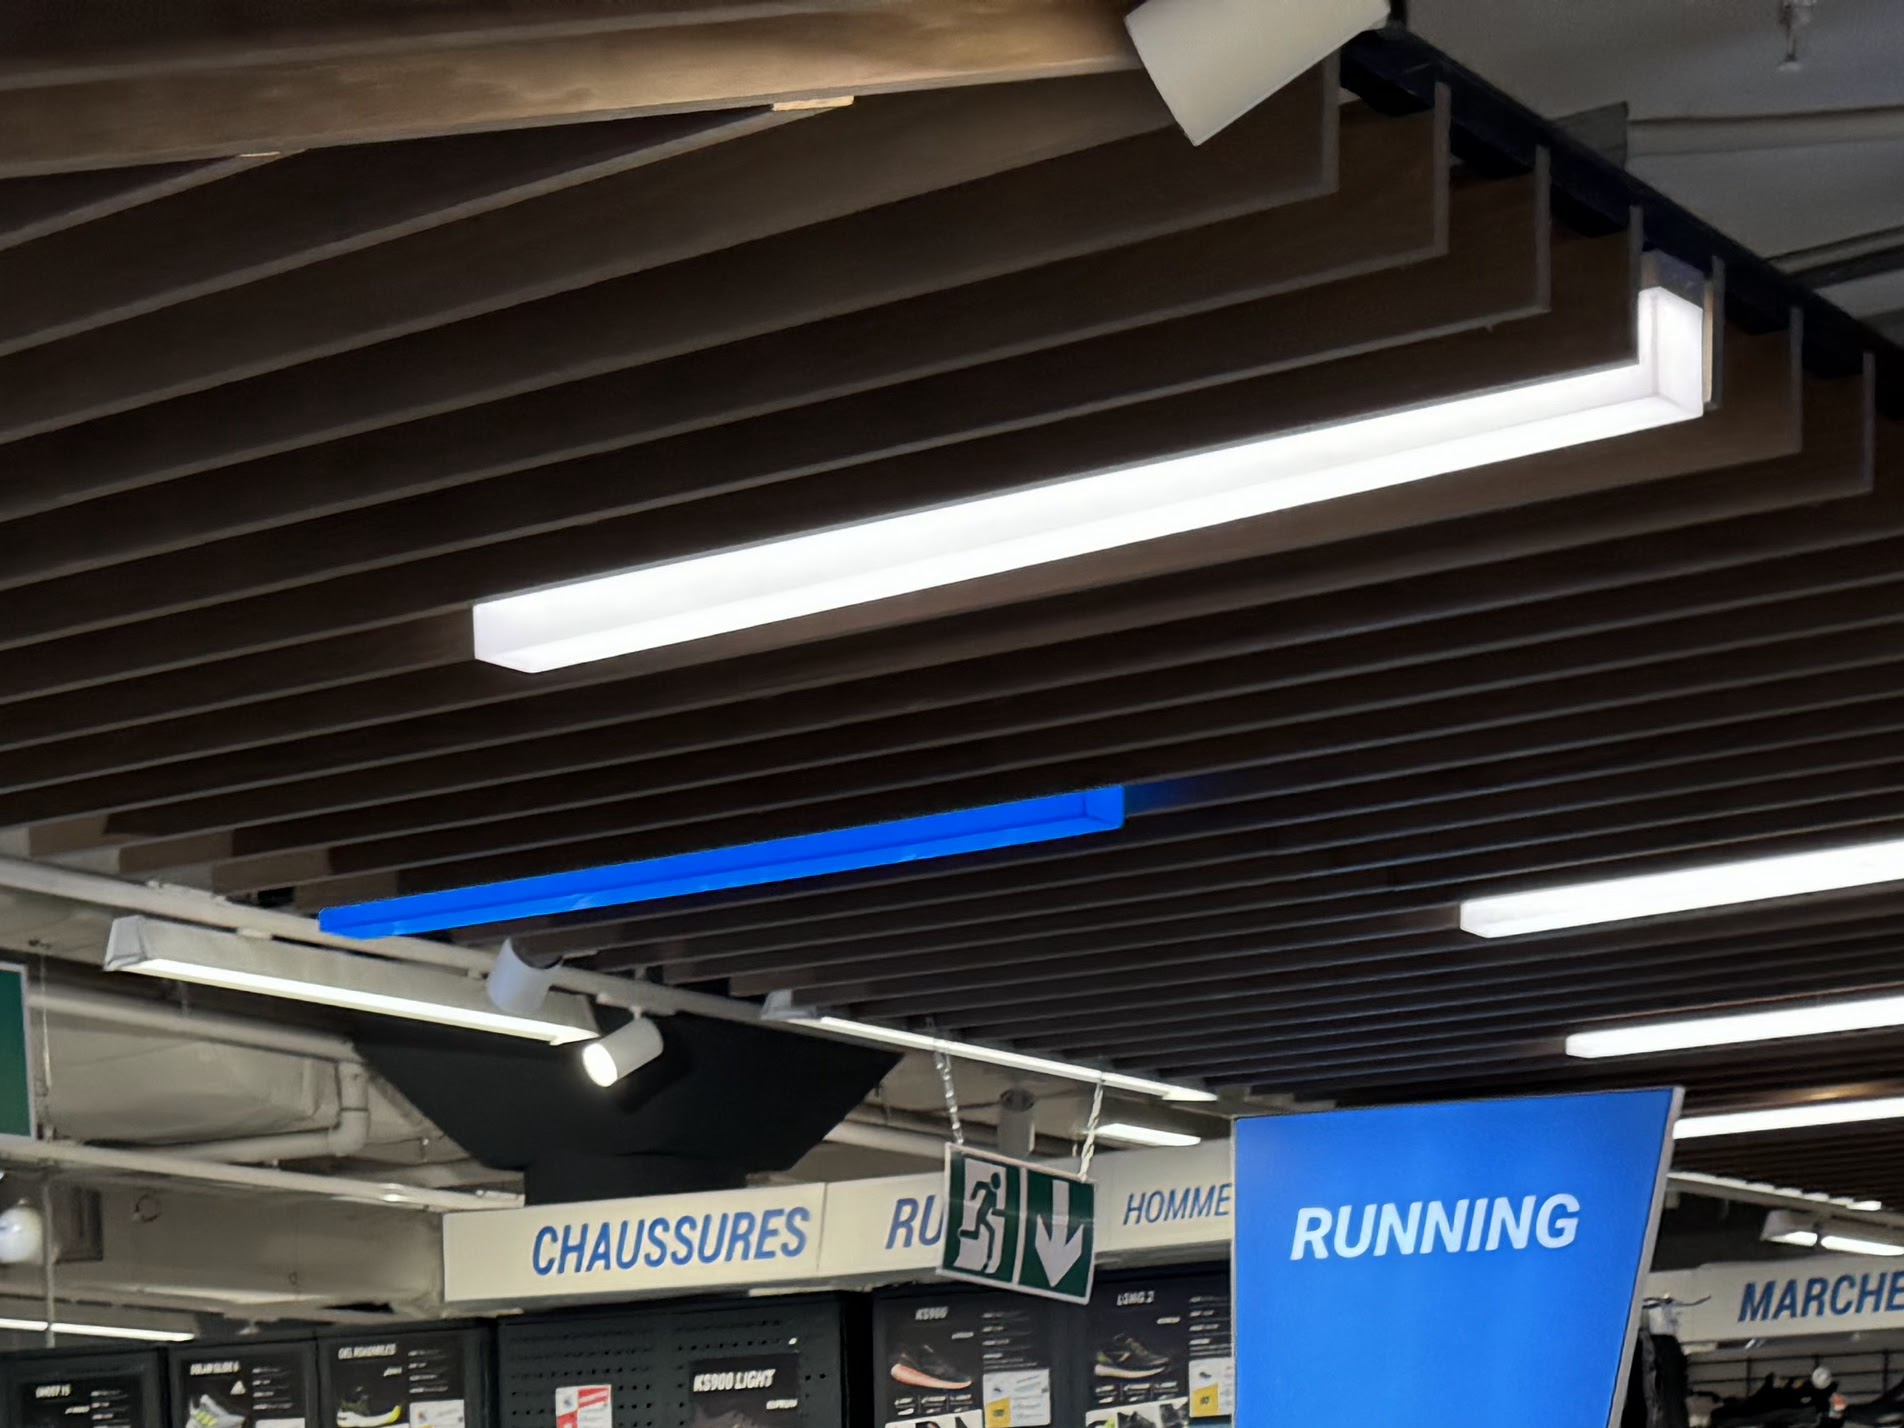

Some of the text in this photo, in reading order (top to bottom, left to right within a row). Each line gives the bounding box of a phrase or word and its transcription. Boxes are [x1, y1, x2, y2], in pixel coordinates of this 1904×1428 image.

[1123, 1183, 1233, 1226] HOMME
[1289, 1193, 1582, 1261] RUNNING
[530, 1206, 810, 1276] CHAUSSURES
[692, 1367, 776, 1392] KS900 LIGHT
